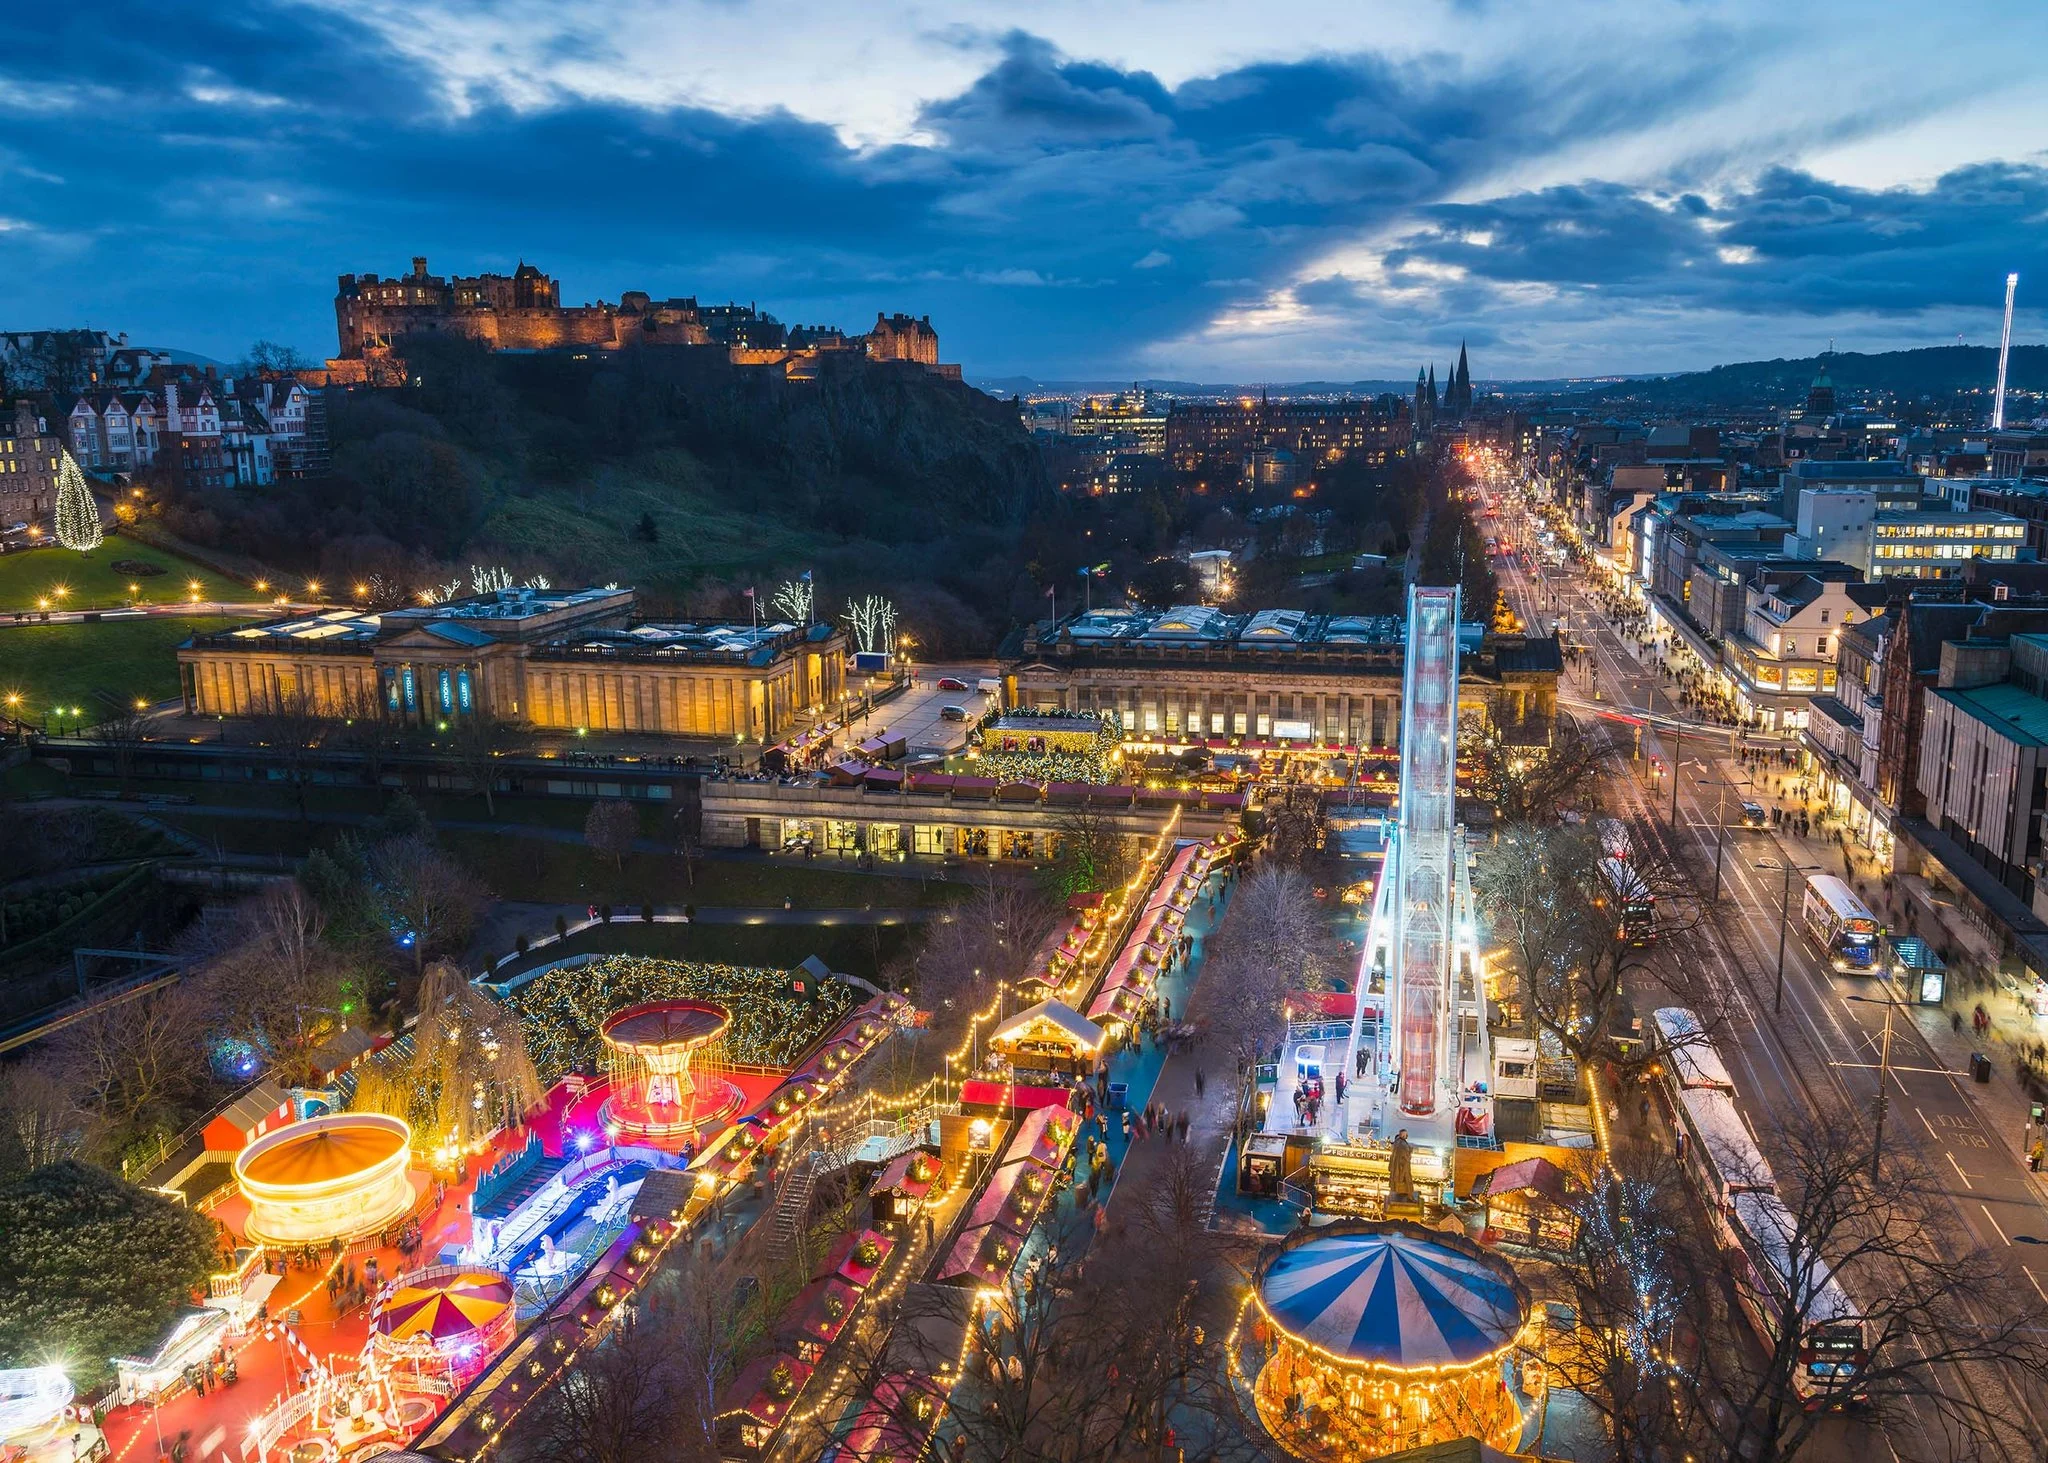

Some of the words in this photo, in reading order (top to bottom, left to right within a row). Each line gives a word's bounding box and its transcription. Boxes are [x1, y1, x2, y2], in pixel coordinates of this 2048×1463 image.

[442, 677, 450, 708] NATIONAL
[461, 682, 469, 708] GALLERY
[1355, 1152, 1377, 1160] CHIPS
